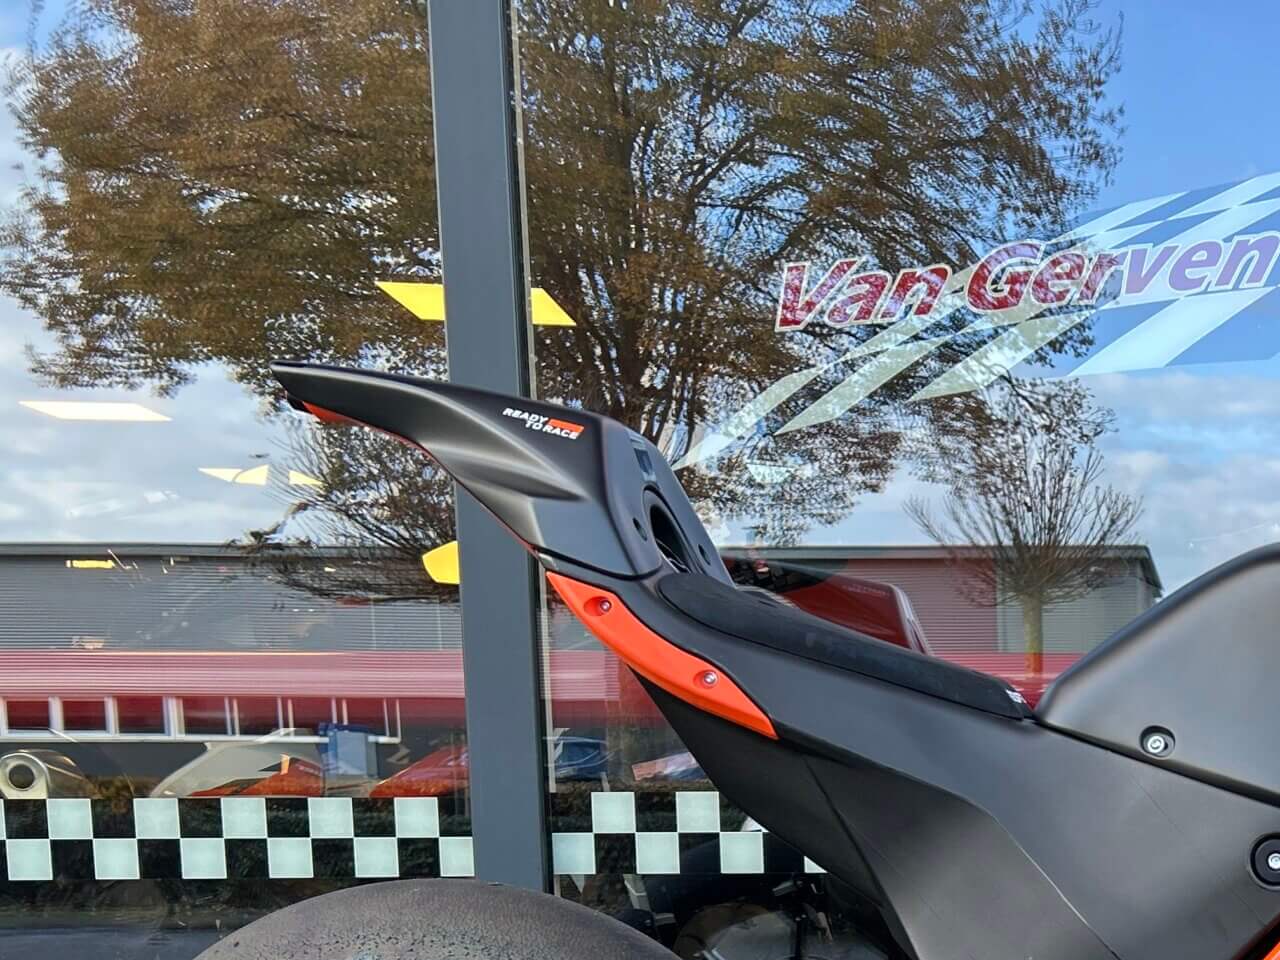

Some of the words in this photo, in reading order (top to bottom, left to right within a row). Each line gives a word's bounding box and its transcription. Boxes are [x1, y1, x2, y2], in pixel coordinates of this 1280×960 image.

[774, 257, 953, 333] Van
[502, 407, 549, 423] READY
[525, 420, 543, 430] TO
[542, 424, 579, 440] RACE
